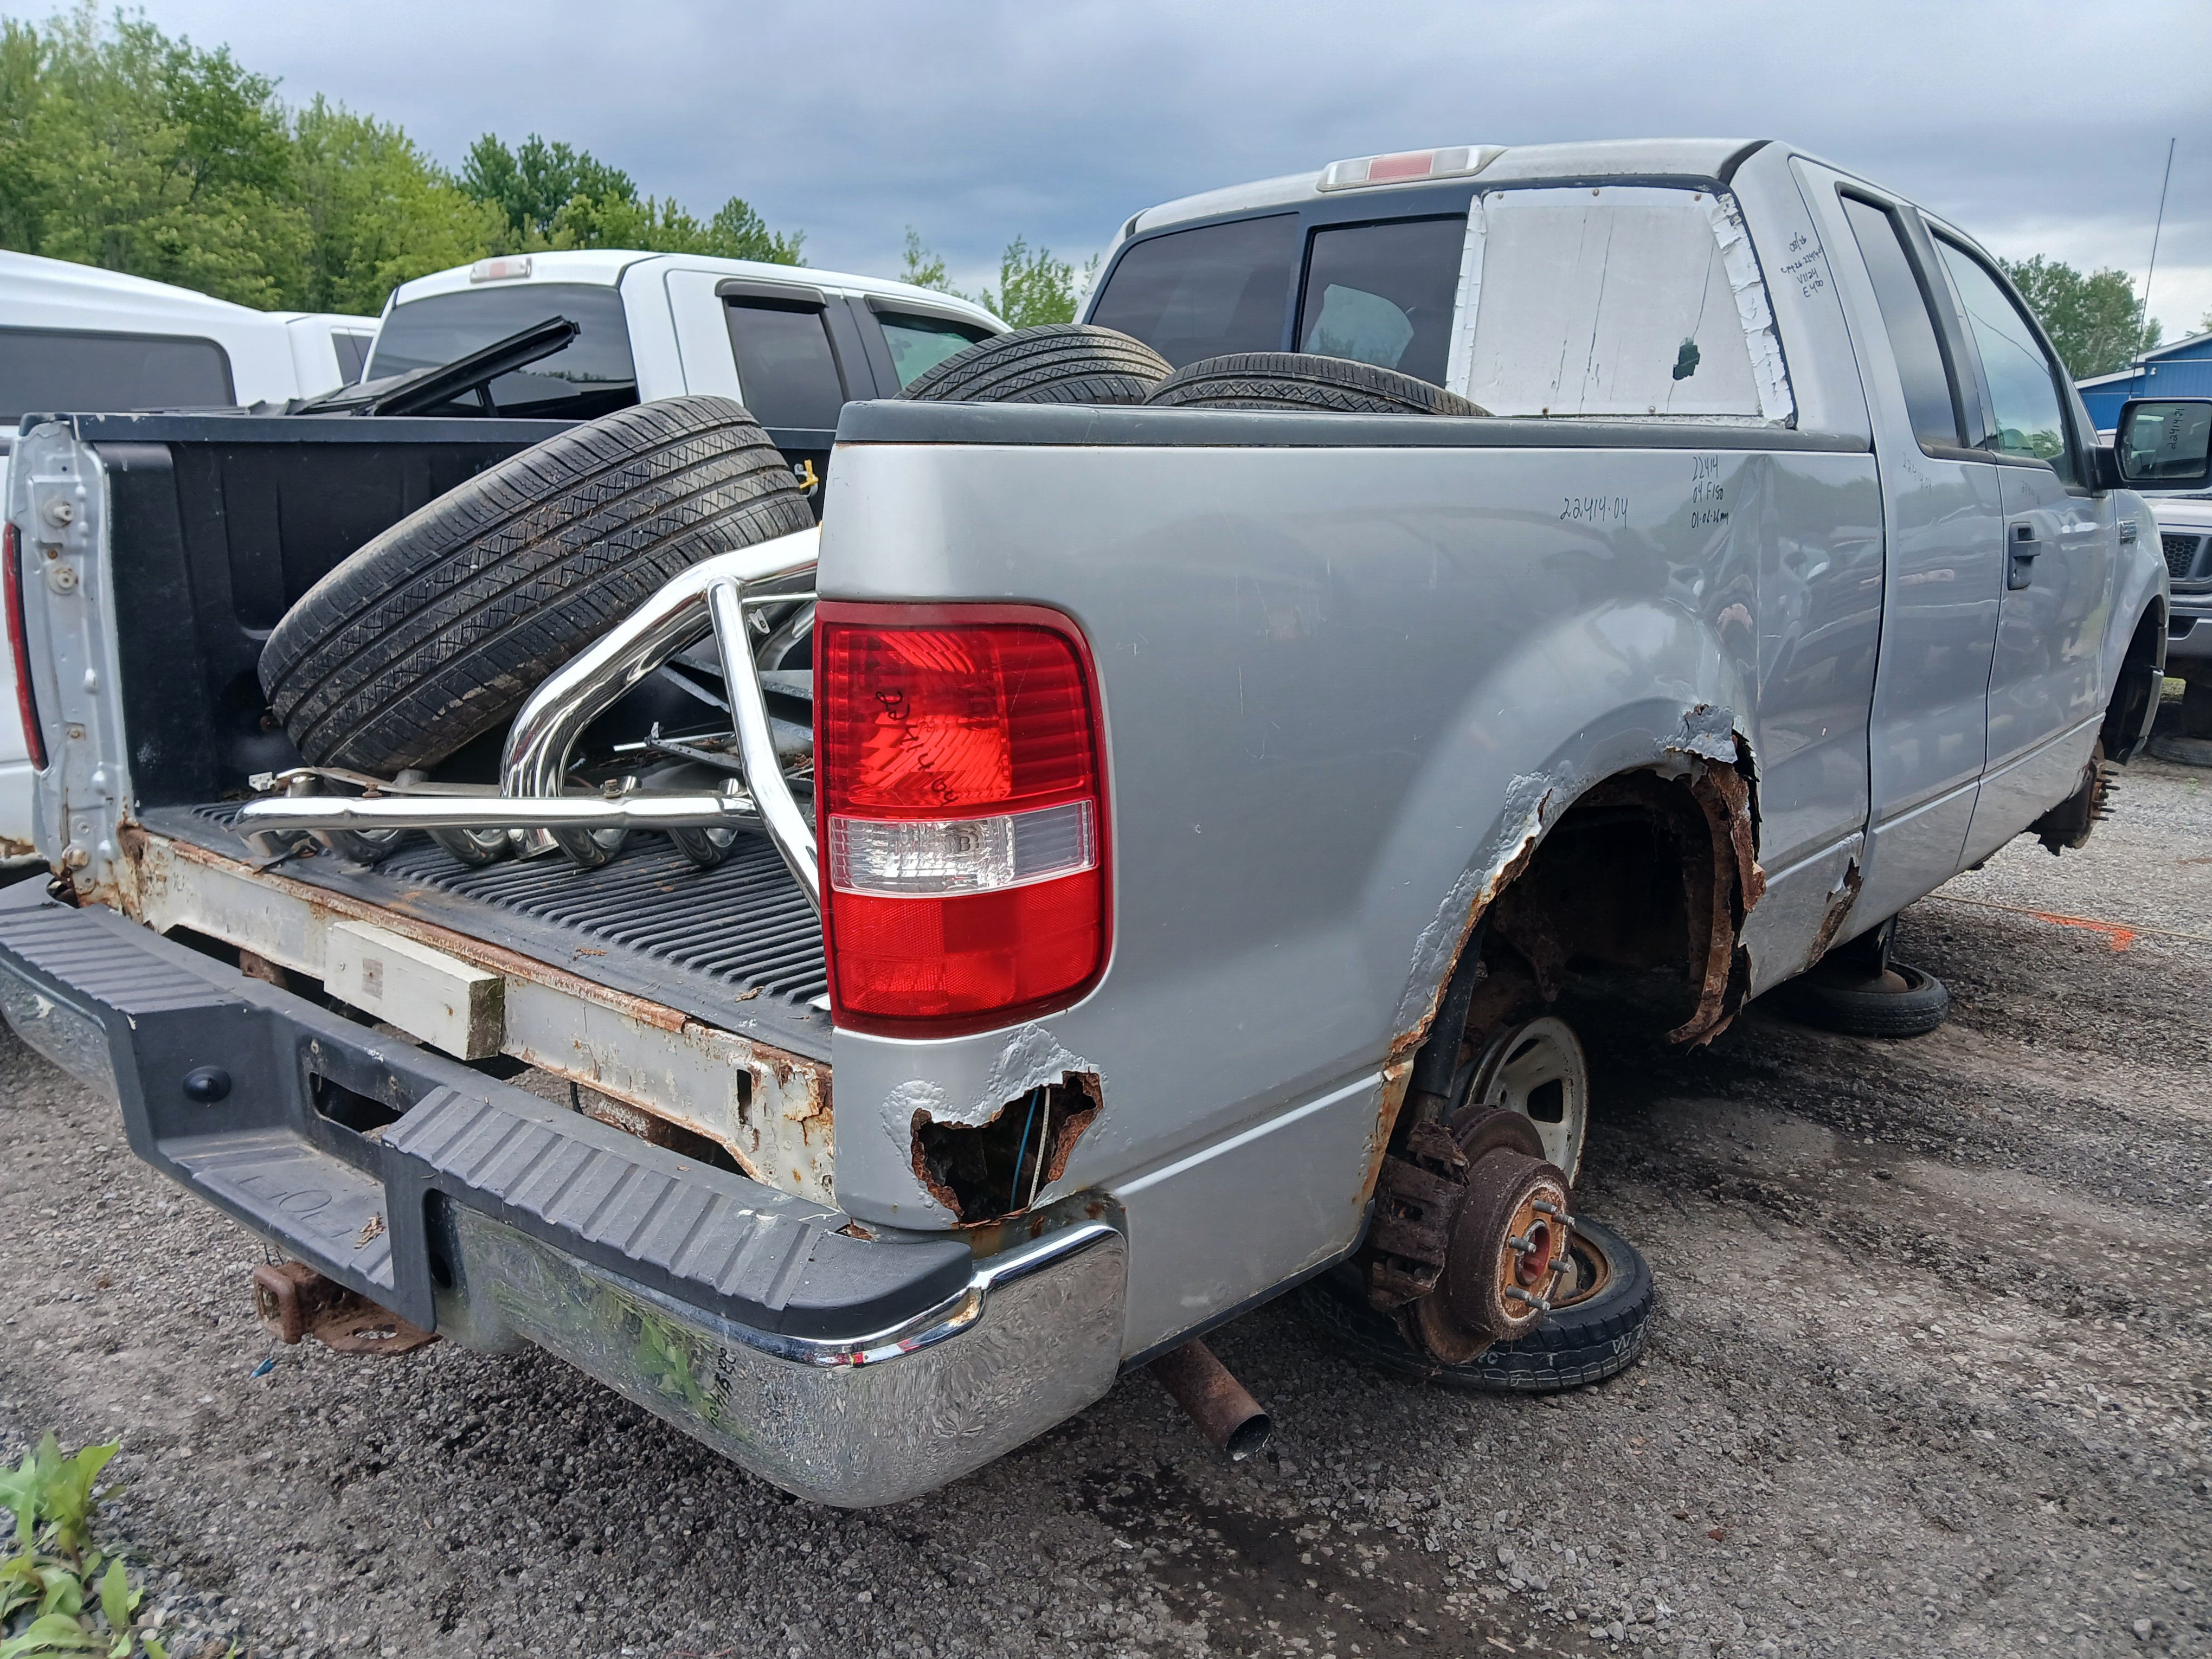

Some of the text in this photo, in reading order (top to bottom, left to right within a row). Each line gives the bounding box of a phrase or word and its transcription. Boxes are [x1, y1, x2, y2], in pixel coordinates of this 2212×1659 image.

[1692, 454, 1718, 481] 22414
[1693, 481, 1702, 504] 04
[1560, 497, 1628, 529] 22414.04
